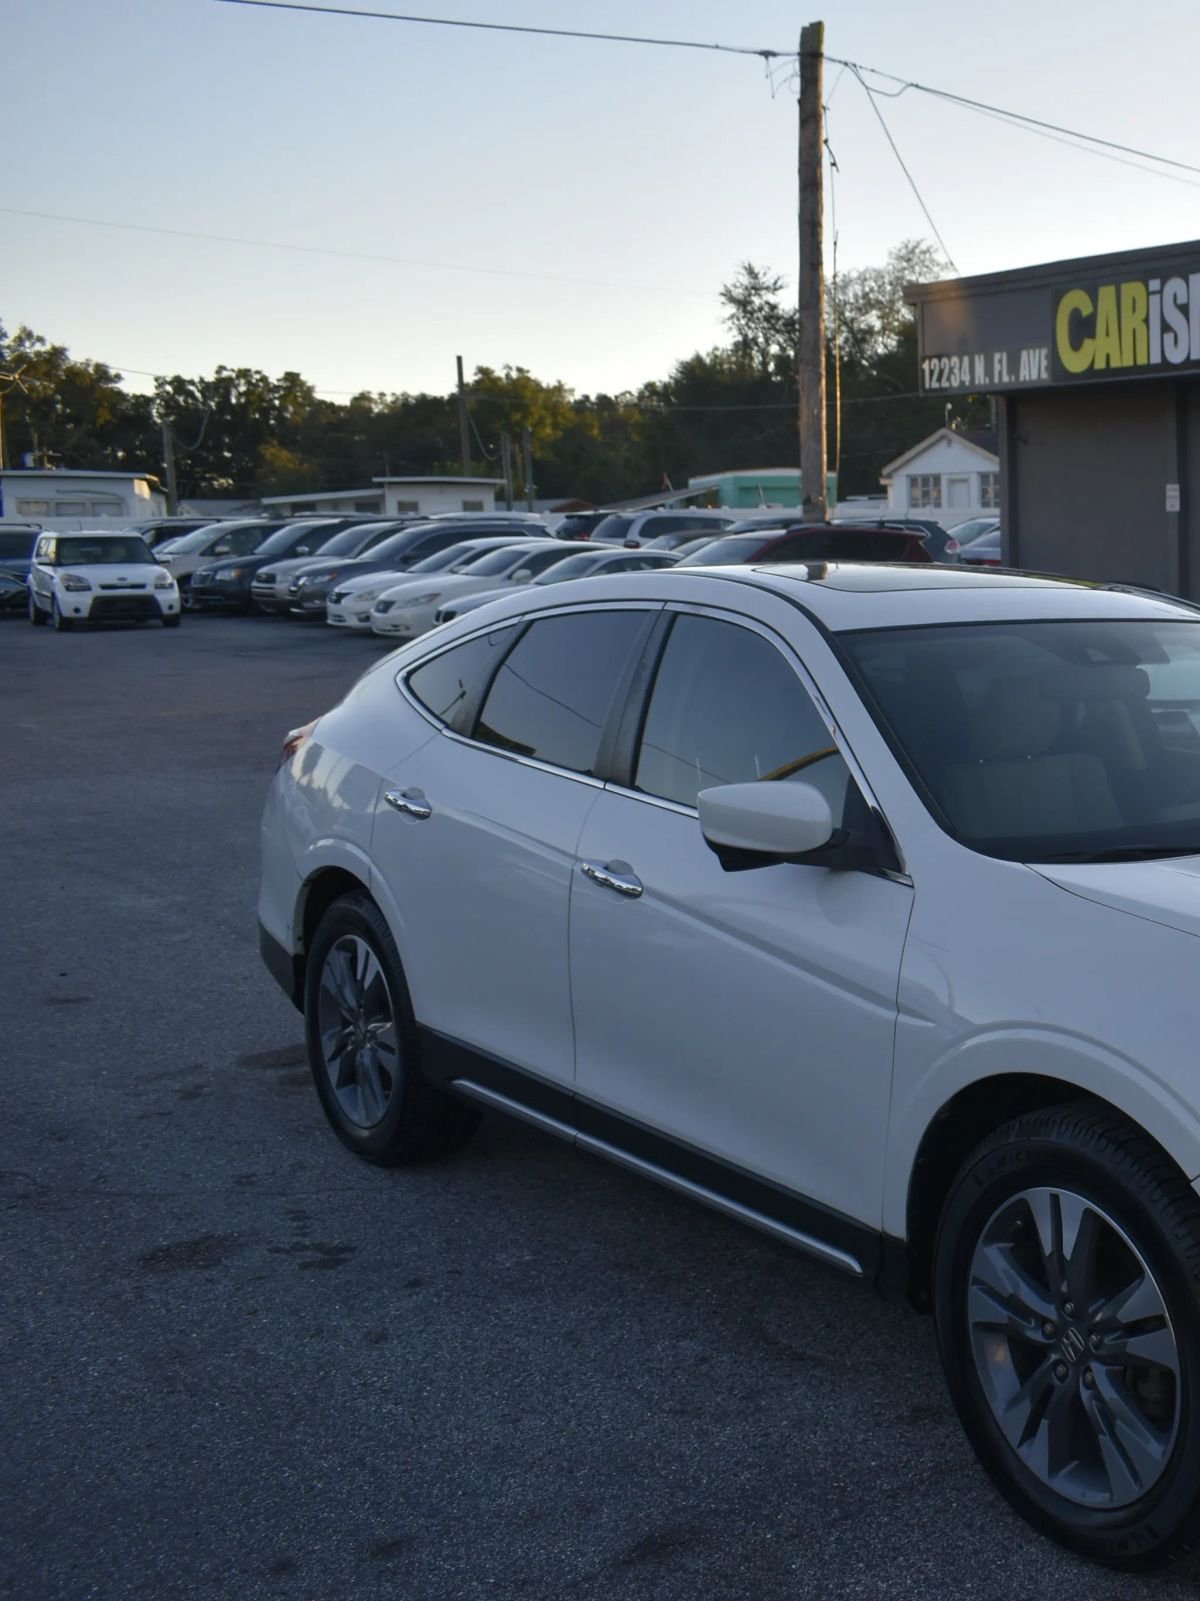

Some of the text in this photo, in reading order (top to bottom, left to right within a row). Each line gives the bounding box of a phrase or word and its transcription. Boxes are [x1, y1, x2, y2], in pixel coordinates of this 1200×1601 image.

[922, 347, 1048, 389] 12234 N. FL. AVE
